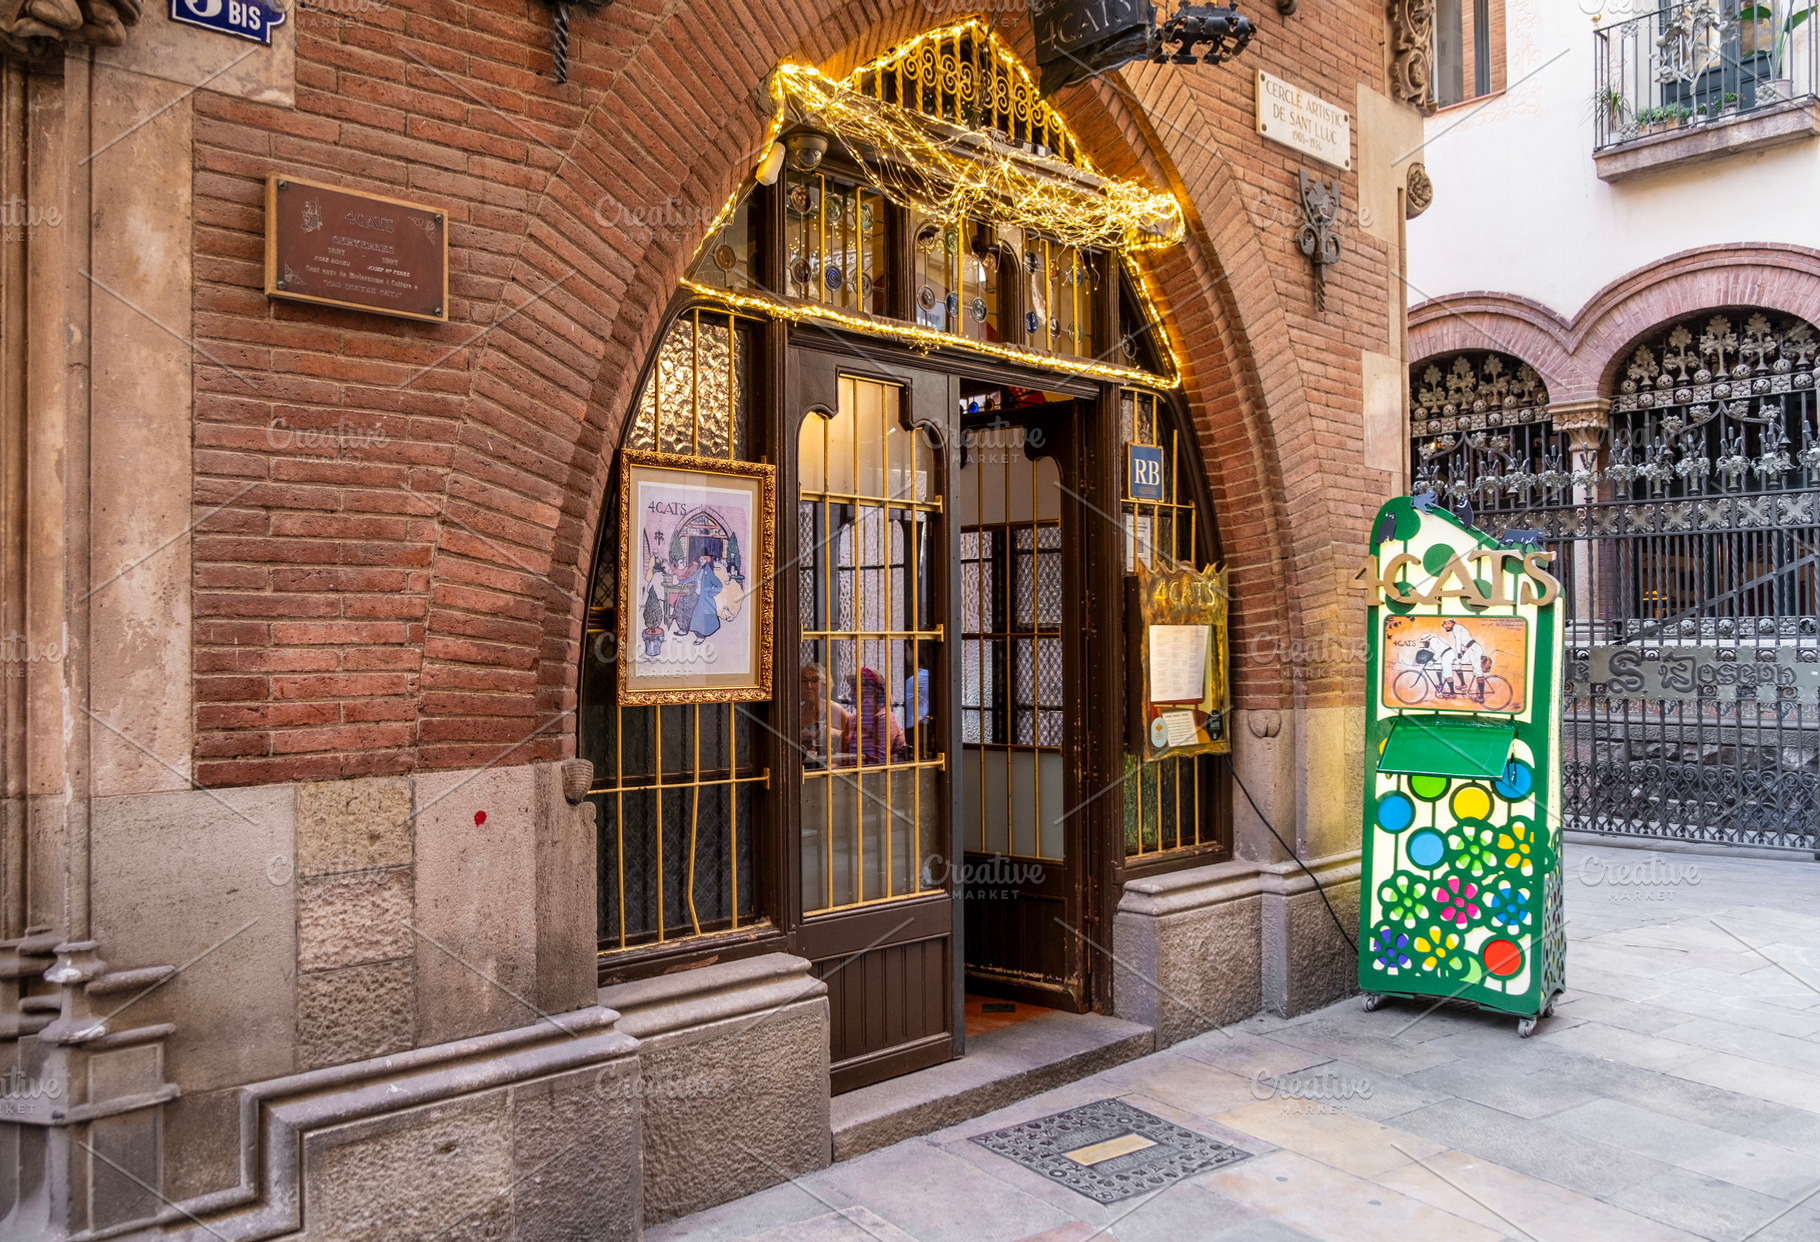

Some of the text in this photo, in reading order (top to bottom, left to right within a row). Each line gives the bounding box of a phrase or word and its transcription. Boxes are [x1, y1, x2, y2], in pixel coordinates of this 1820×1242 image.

[229, 0, 261, 30] BIS
[1266, 80, 1343, 128] CERCLE ARTISTIC
[1273, 103, 1337, 145] DE SANT LLUC
[345, 211, 395, 233] 4CATS
[1134, 458, 1160, 486] RB
[648, 500, 687, 516] 4CATS
[1153, 578, 1216, 607] 4CATS
[1347, 549, 1558, 607] 4CATS
